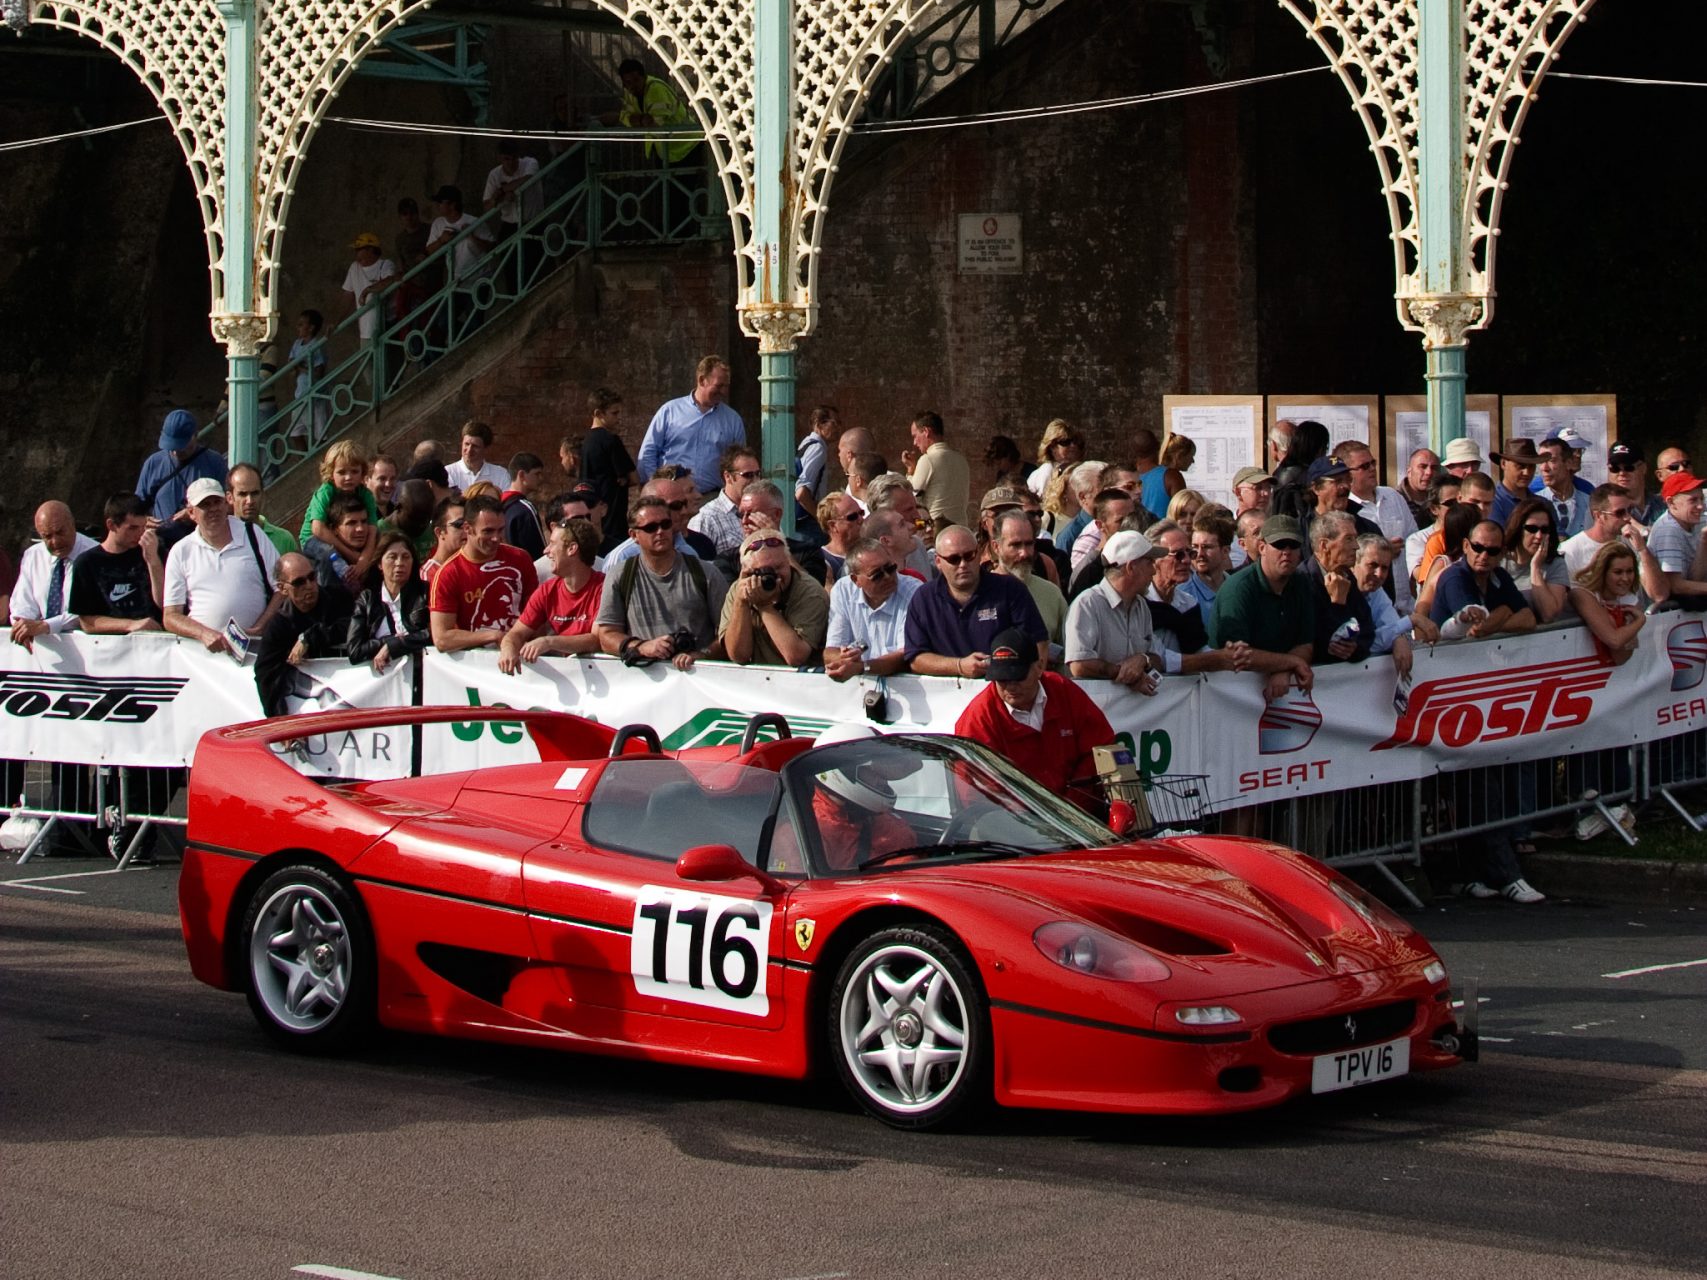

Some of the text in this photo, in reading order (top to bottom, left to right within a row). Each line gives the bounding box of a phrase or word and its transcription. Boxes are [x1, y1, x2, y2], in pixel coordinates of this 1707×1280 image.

[1657, 698, 1707, 726] SEA
[1239, 759, 1332, 793] SEAT
[639, 900, 761, 1000] 116
[1334, 1045, 1394, 1083] TPV 16
